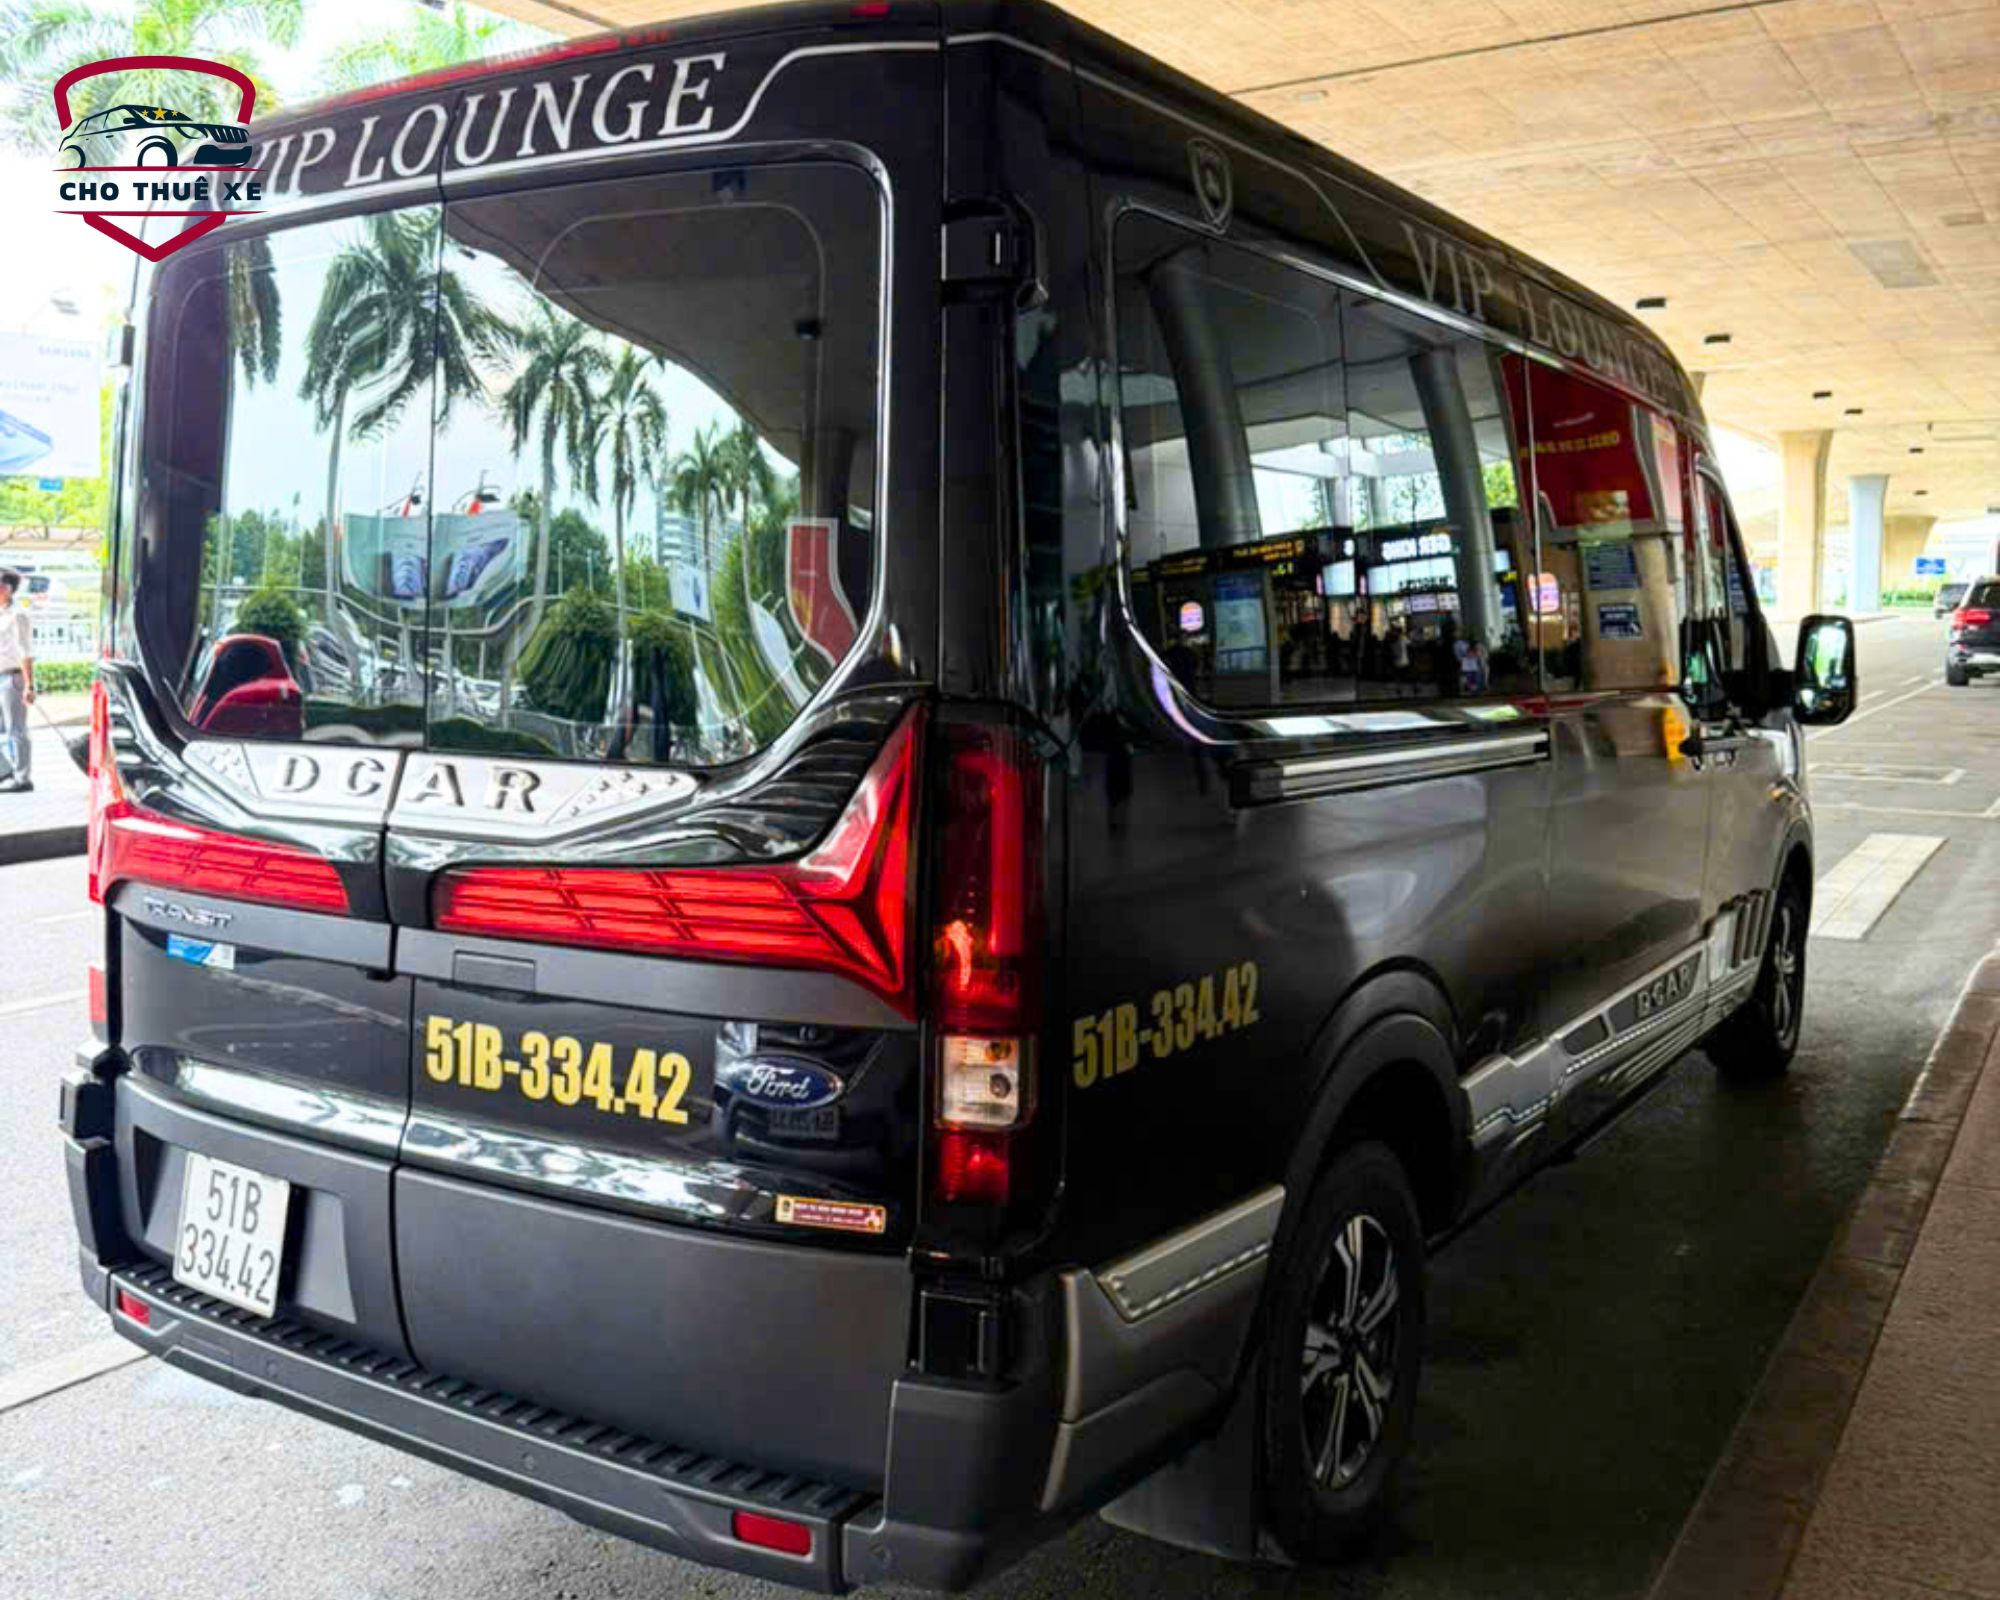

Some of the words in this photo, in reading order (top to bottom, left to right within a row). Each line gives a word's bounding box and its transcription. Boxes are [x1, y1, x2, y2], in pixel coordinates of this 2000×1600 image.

[343, 52, 726, 188] LOUNGE
[1400, 221, 1494, 321] VIP
[1073, 961, 1260, 1088] 51B-334.42
[1638, 965, 1690, 1018] DCAR
[425, 1015, 692, 1125] 51B-334.42
[747, 1064, 812, 1099] Ford
[207, 1169, 262, 1235] 51B
[181, 1223, 276, 1305] 334.42
